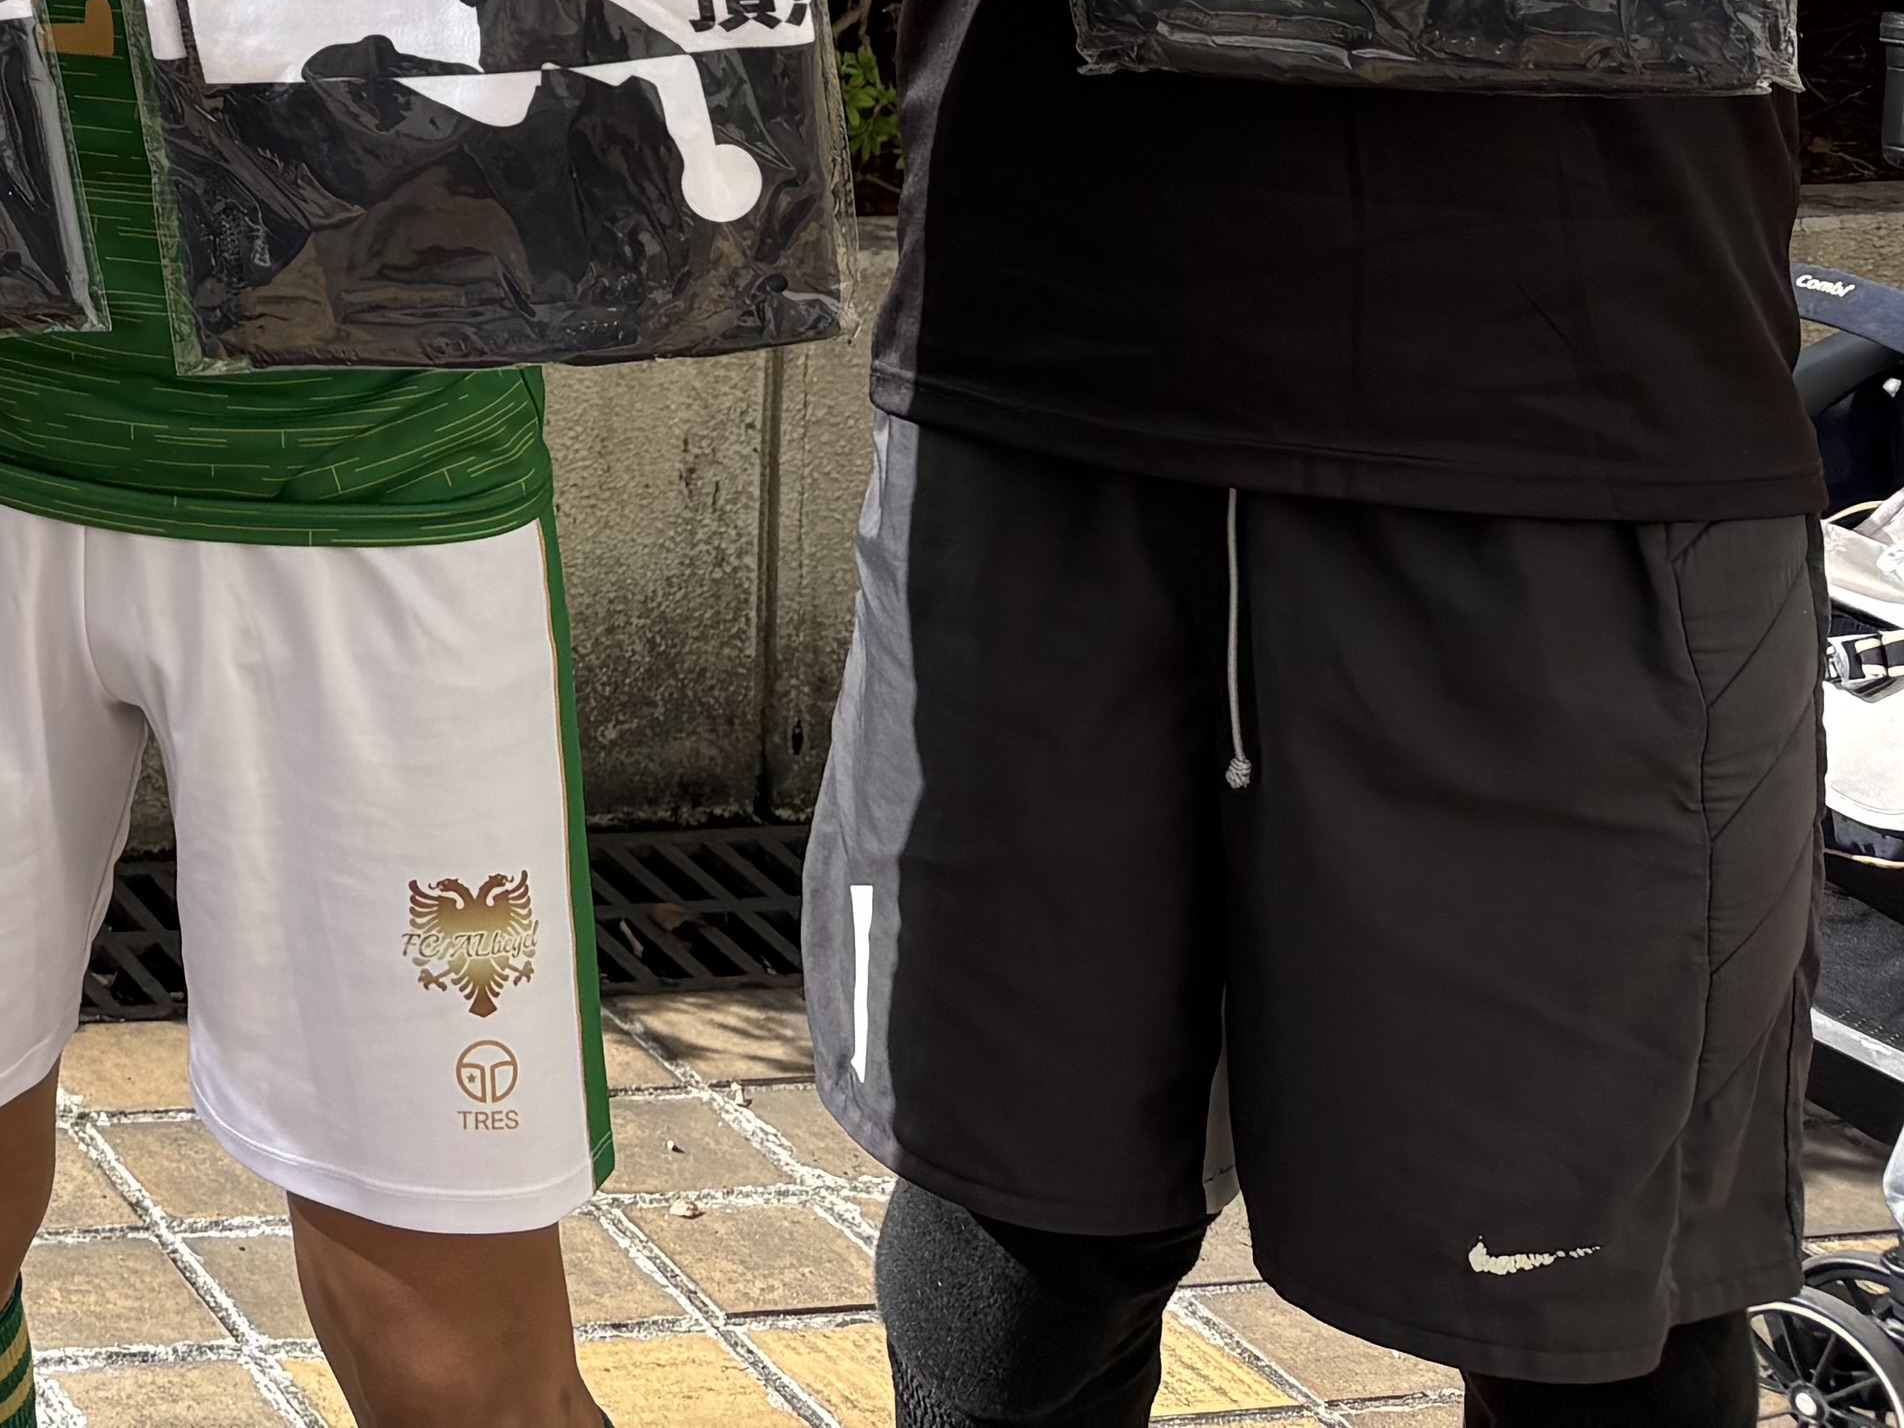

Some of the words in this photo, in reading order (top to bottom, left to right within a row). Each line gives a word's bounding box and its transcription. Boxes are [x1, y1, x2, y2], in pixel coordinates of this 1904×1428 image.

[1796, 274, 1856, 297] Combi
[402, 932, 440, 958] FC
[457, 1110, 520, 1131] TRES
